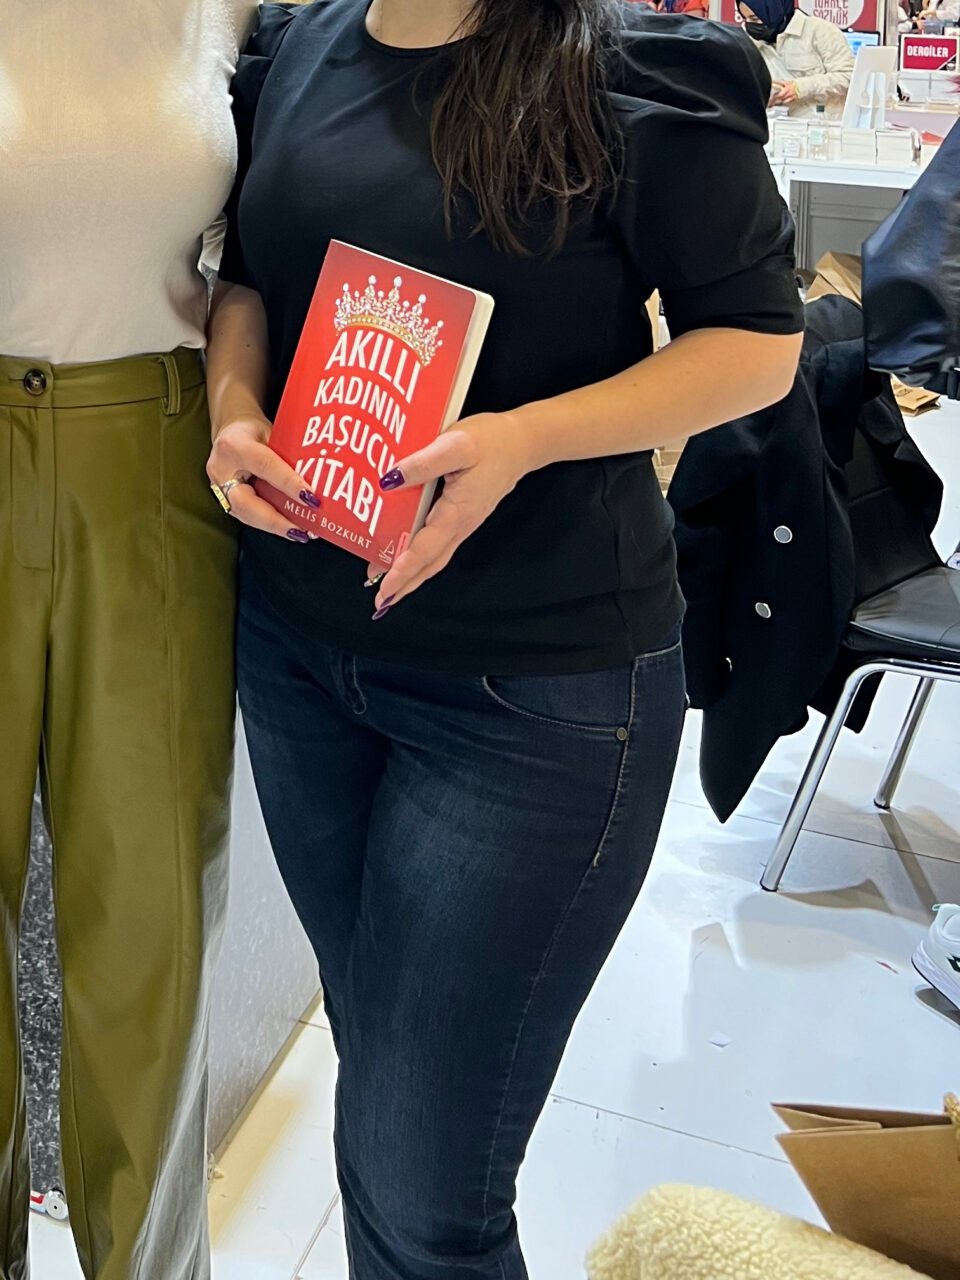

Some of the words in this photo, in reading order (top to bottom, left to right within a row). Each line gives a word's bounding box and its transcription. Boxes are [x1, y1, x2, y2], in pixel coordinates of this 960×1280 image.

[324, 331, 420, 404] AKILLI
[313, 376, 407, 444] KADININ
[302, 414, 396, 478] BAŞUCU
[284, 500, 317, 522] MELİS
[321, 517, 372, 549] BOZKURT
[295, 449, 384, 537] KİTABI
